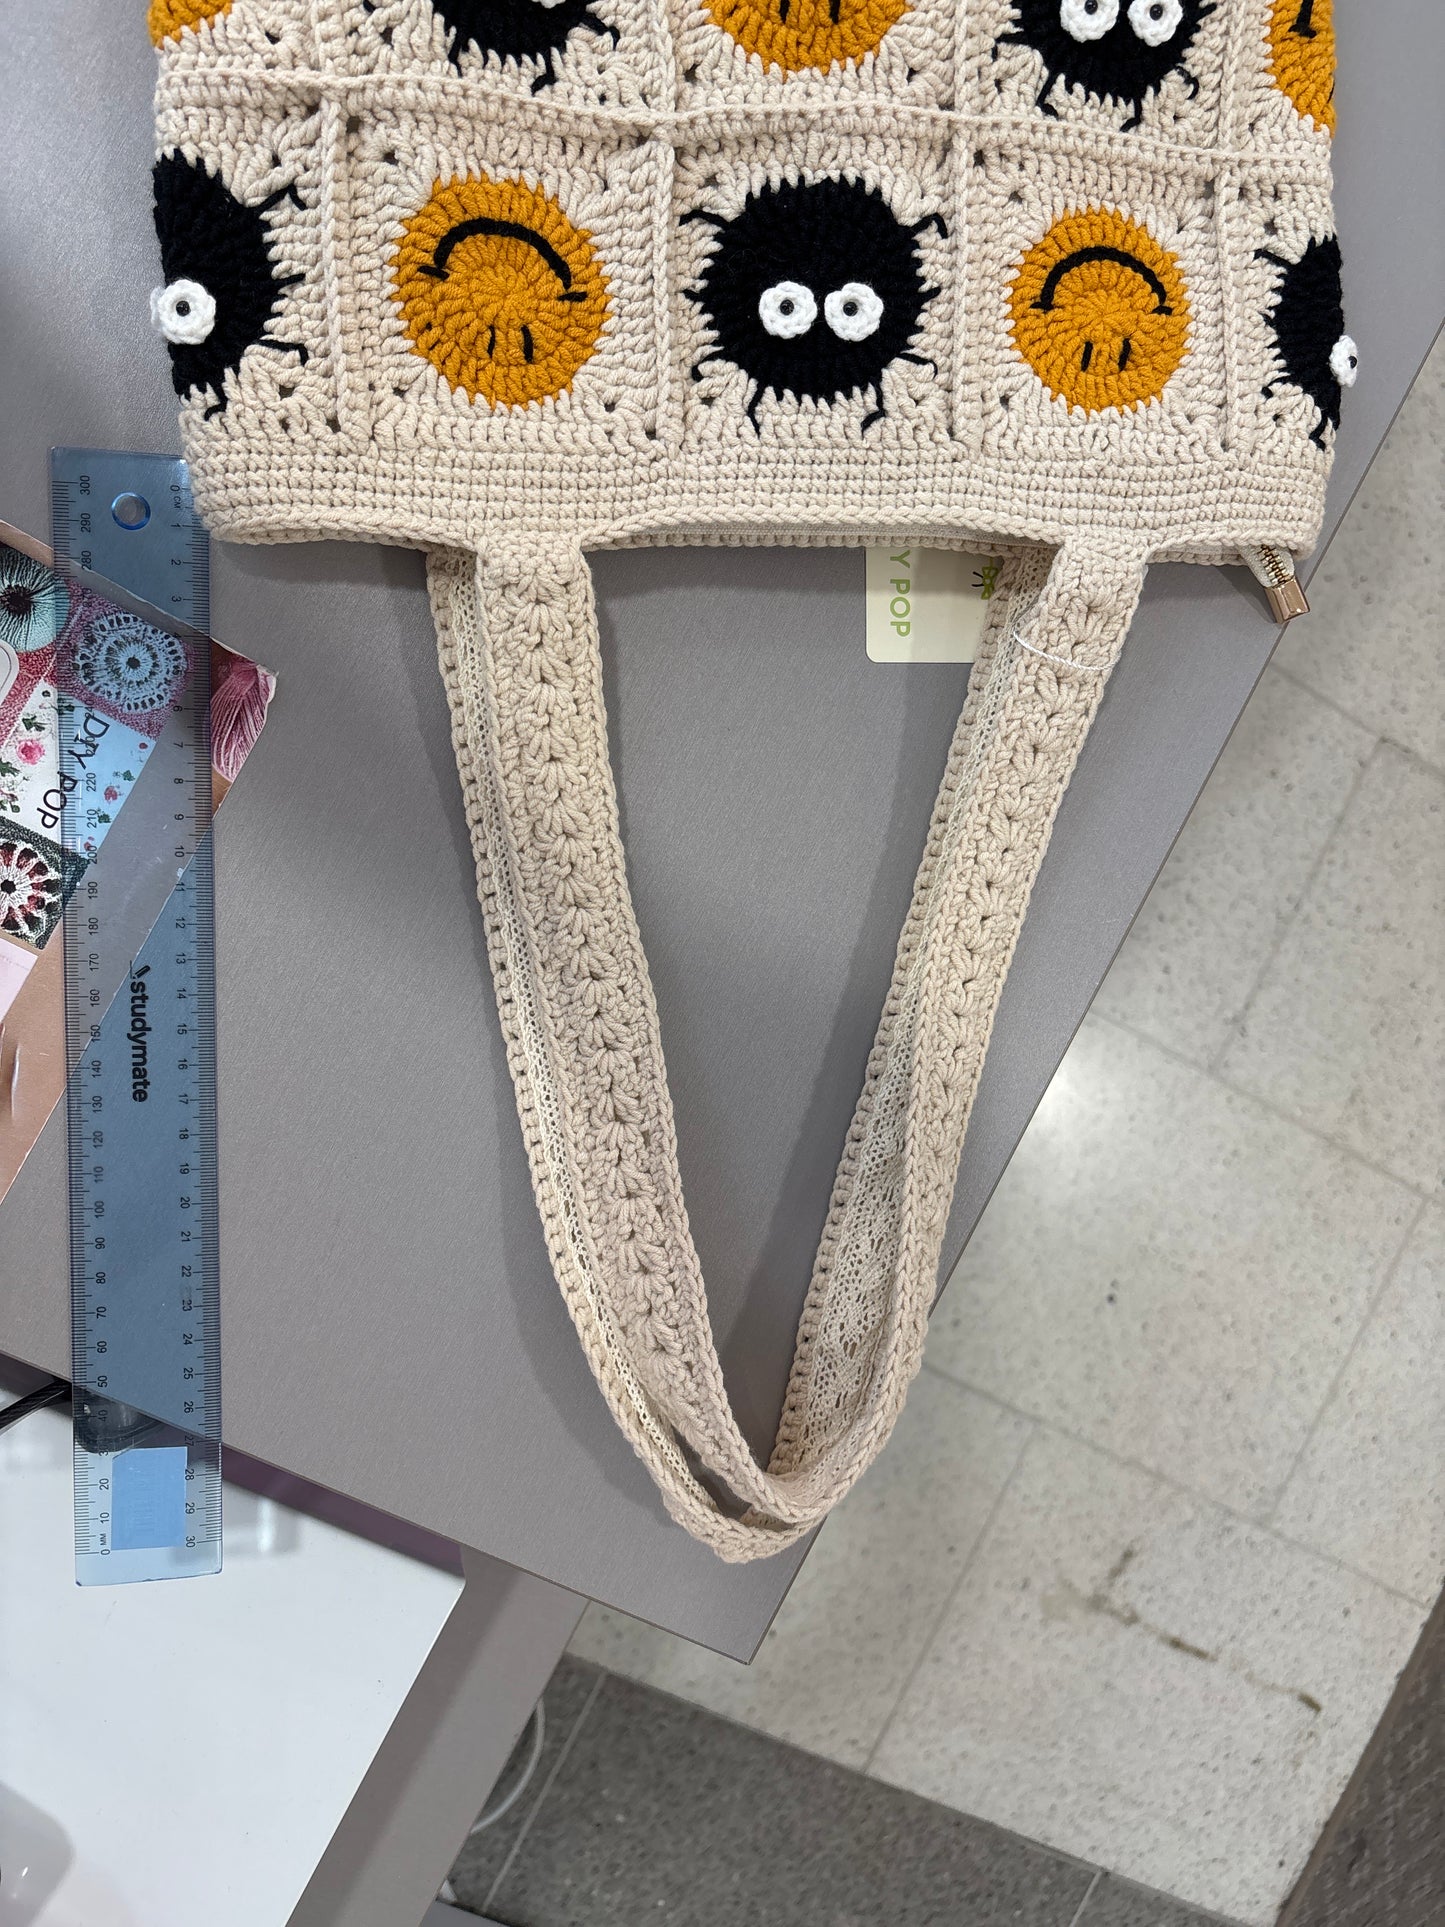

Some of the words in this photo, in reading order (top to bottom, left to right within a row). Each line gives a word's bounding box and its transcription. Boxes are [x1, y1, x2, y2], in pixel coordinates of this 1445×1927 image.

[79, 475, 91, 496] 300
[80, 512, 91, 533] 290
[81, 550, 92, 571] 280
[890, 578, 911, 638] POP
[68, 713, 110, 769] DIY
[86, 772, 96, 792] 220
[174, 777, 184, 785] 8
[37, 771, 78, 829] POP
[87, 809, 97, 829] 210
[174, 813, 184, 821] 9
[87, 845, 98, 865] 200
[174, 845, 184, 858] 10
[88, 881, 98, 899] 190
[175, 882, 185, 892] 11
[88, 917, 98, 935] 180
[175, 917, 186, 929] 12
[89, 953, 99, 971] 170
[176, 953, 186, 965] 13
[90, 989, 100, 1007] 160
[176, 988, 187, 1000] 14
[91, 1024, 101, 1043] 150
[177, 1023, 187, 1035] 15
[127, 981, 152, 1103] studymate
[91, 1060, 101, 1078] 140
[178, 1058, 188, 1070] 16
[92, 1095, 102, 1113] 130
[178, 1093, 189, 1105] 17
[93, 1130, 103, 1148] 120
[179, 1128, 189, 1140] 18
[94, 1166, 104, 1183] 110
[179, 1163, 189, 1175] 19
[180, 1197, 190, 1209] 20
[95, 1201, 104, 1219] 100
[180, 1231, 191, 1242] 21
[95, 1237, 105, 1250] 90
[181, 1265, 192, 1278] 22
[96, 1272, 106, 1285] 80
[182, 1299, 192, 1312] 23
[96, 1306, 107, 1319] 70
[182, 1333, 193, 1345] 24
[97, 1341, 107, 1354] 60
[183, 1367, 193, 1380] 25
[98, 1375, 108, 1388] 50
[184, 1401, 194, 1413] 26
[98, 1410, 108, 1422] 40
[184, 1435, 194, 1446] 27
[99, 1444, 108, 1456] 30
[185, 1469, 194, 1481] 28
[99, 1478, 109, 1490] 20
[185, 1503, 195, 1515] 29
[100, 1512, 110, 1523] 10
[185, 1535, 196, 1548] 30
